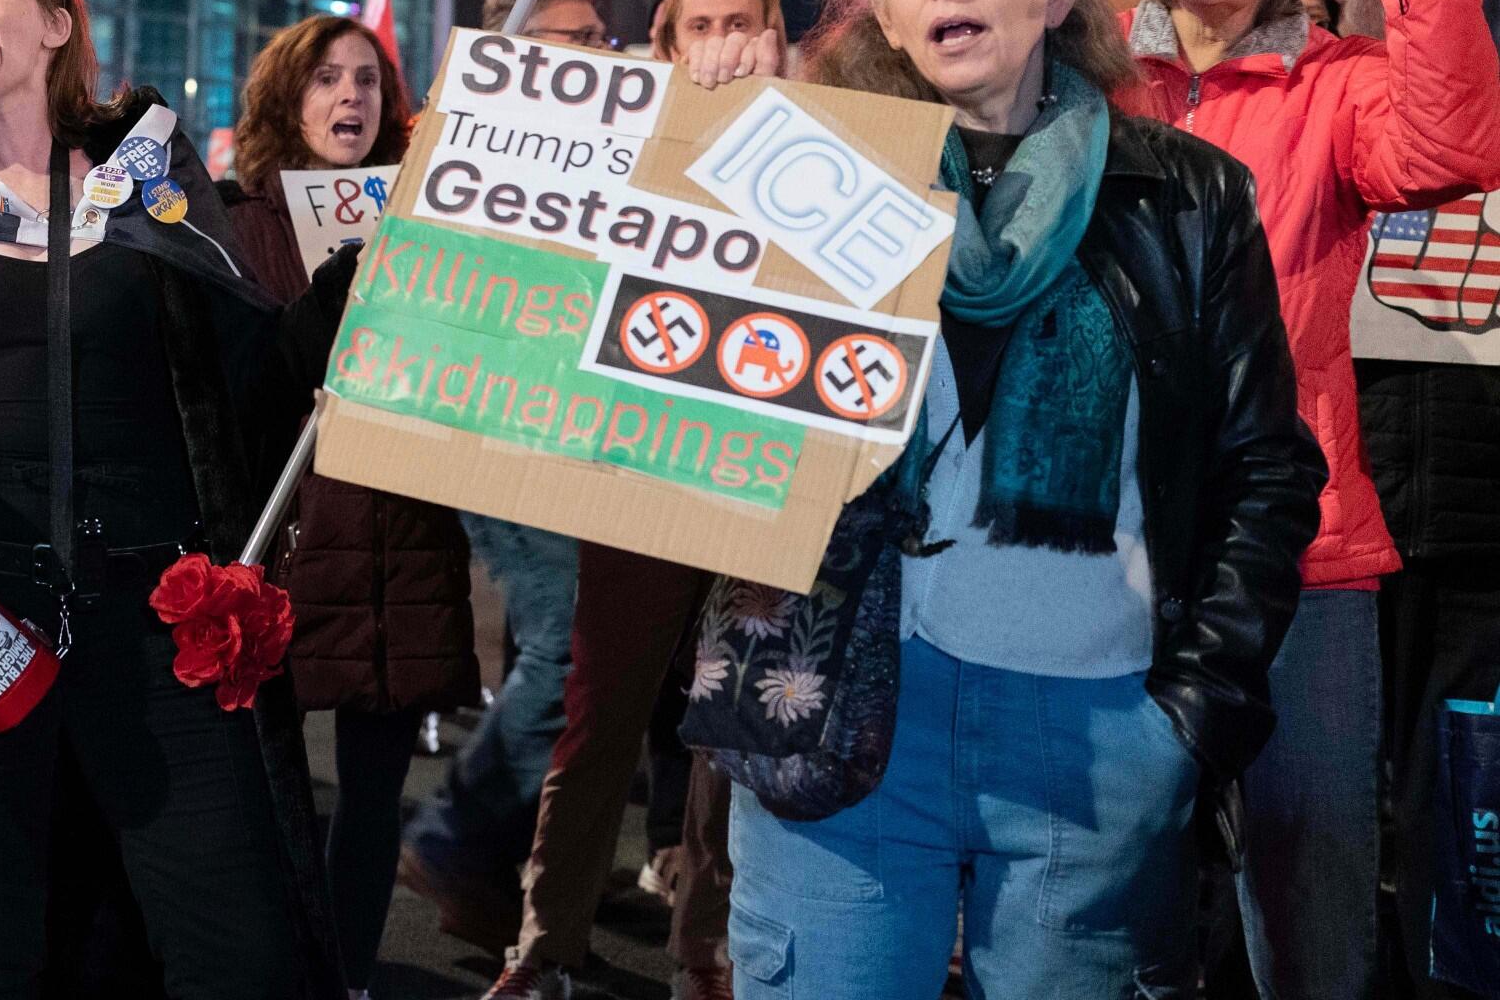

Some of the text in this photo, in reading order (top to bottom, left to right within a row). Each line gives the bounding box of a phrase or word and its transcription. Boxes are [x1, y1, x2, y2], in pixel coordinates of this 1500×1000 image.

[461, 35, 656, 124] Stop
[101, 166, 123, 175] 1920
[119, 139, 157, 168] FREE
[135, 153, 158, 173] DC
[448, 109, 635, 176] Trump's
[104, 173, 116, 181] We
[713, 107, 934, 291] ICE
[424, 159, 763, 273] Gestapo
[364, 234, 593, 337] Killings
[336, 326, 795, 488] &kidnappings
[17, 645, 36, 671] THEY
